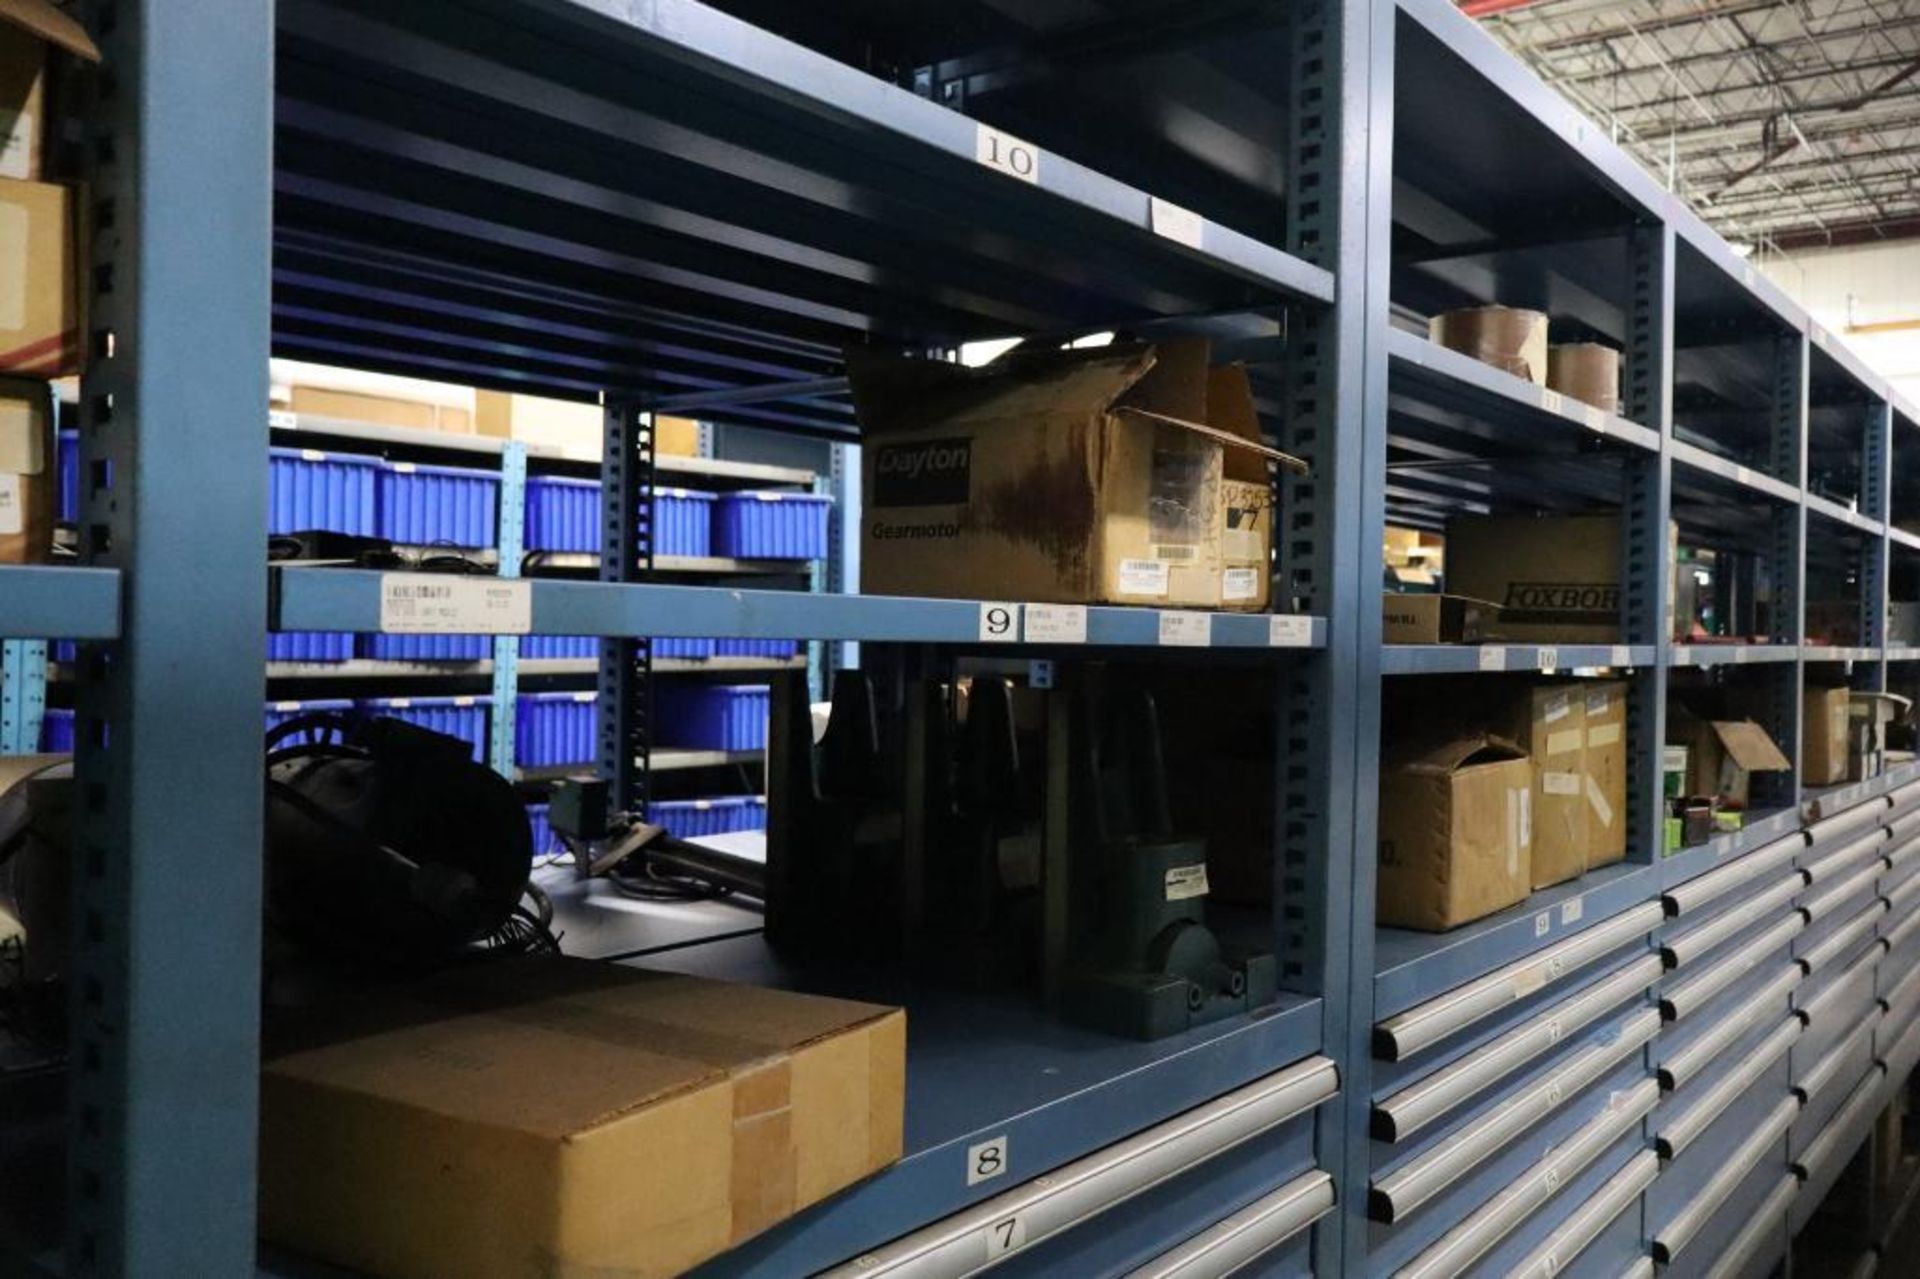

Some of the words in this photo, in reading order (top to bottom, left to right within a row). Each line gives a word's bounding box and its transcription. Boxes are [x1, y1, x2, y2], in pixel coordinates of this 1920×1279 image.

[988, 136, 1033, 176] 10
[878, 444, 969, 479] Dayton
[871, 522, 962, 540] Gearmotor
[986, 607, 1011, 634] 9
[1540, 650, 1557, 667] 10
[976, 1146, 1001, 1175] 8
[995, 1218, 1017, 1249] 7
